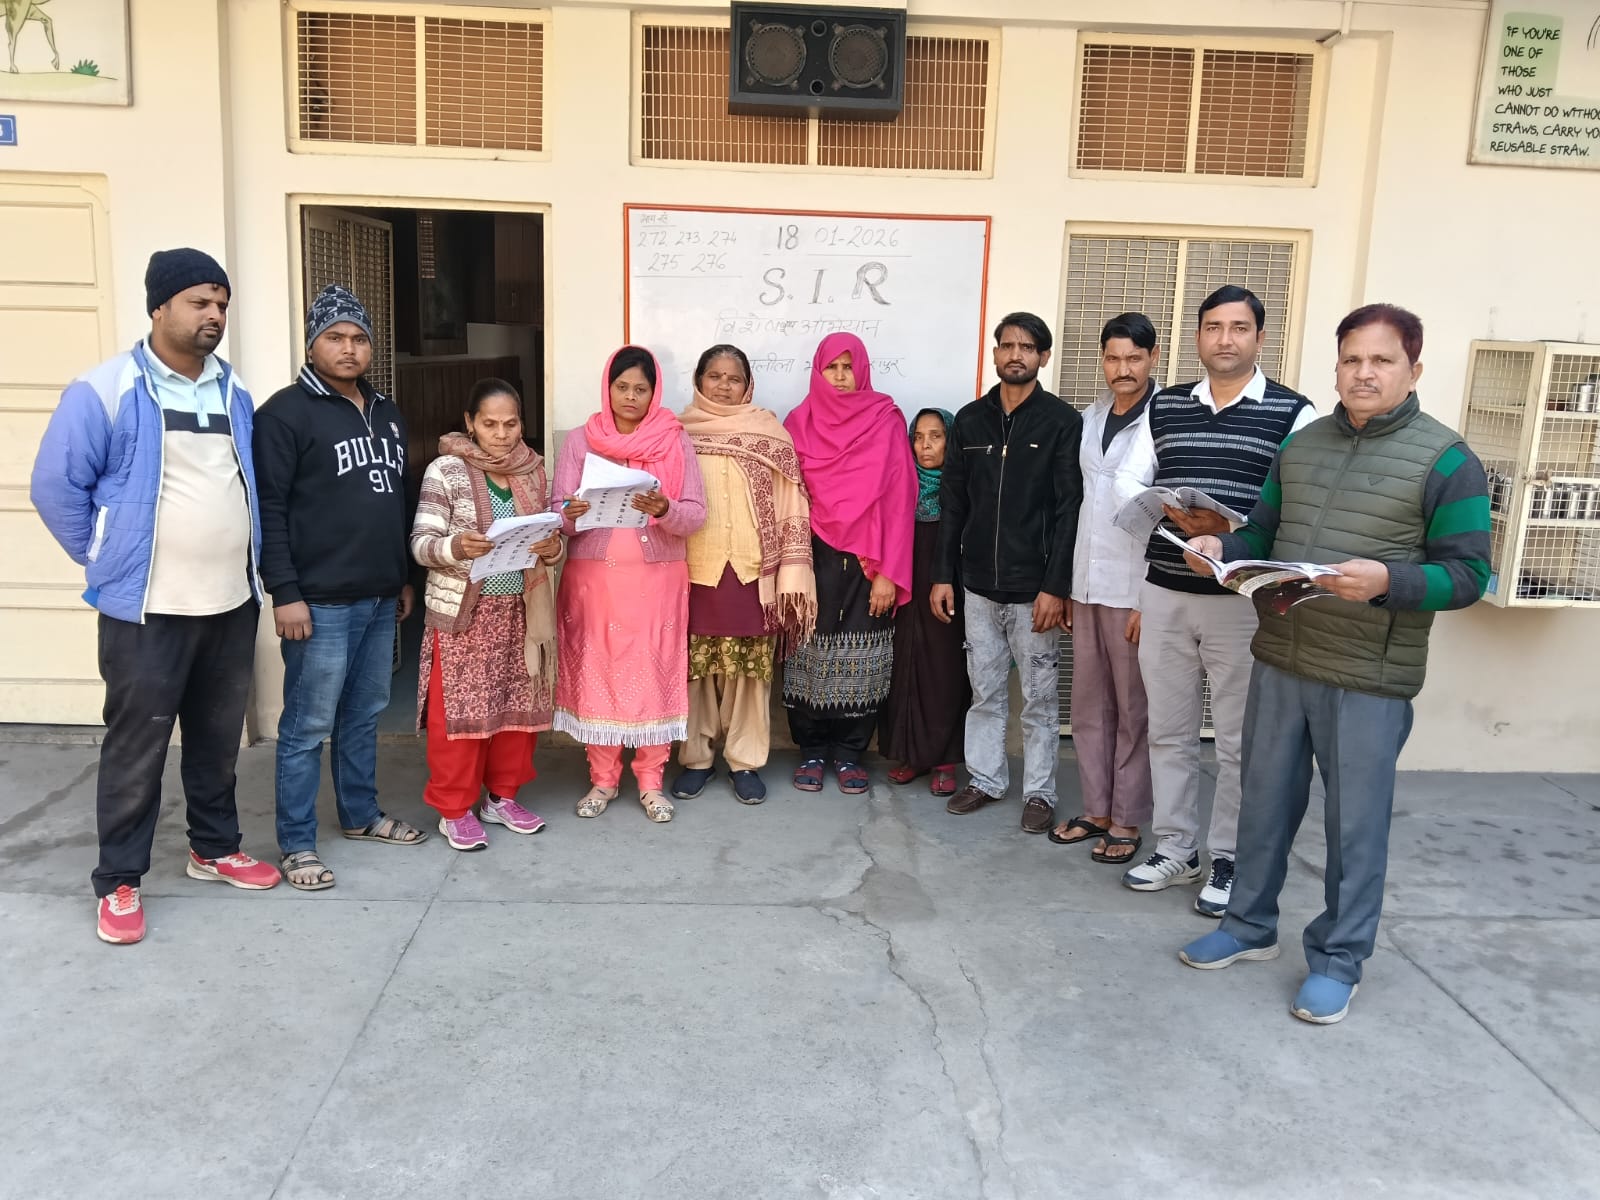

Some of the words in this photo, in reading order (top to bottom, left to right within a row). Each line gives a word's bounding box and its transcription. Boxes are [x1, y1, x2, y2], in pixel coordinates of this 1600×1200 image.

[1522, 27, 1561, 41] YOU'RE
[1503, 45, 1525, 57] ONE
[1528, 46, 1544, 59] OF
[1501, 65, 1537, 78] THOSE
[1498, 84, 1522, 97] WHO
[1526, 86, 1553, 98] JUST
[1494, 101, 1541, 117] CANNOT
[1543, 105, 1559, 118] DO
[1542, 123, 1583, 138] CARRY
[1585, 127, 1600, 139] YO
[1490, 140, 1547, 154] REUSABLE
[1550, 143, 1590, 157] STRAW.
[707, 230, 737, 248] 274
[777, 224, 799, 250] 18
[815, 225, 900, 248] 01-2026
[647, 252, 685, 272] 275
[690, 252, 728, 273] 276
[333, 436, 404, 477] BULLS
[368, 469, 394, 493] 91
